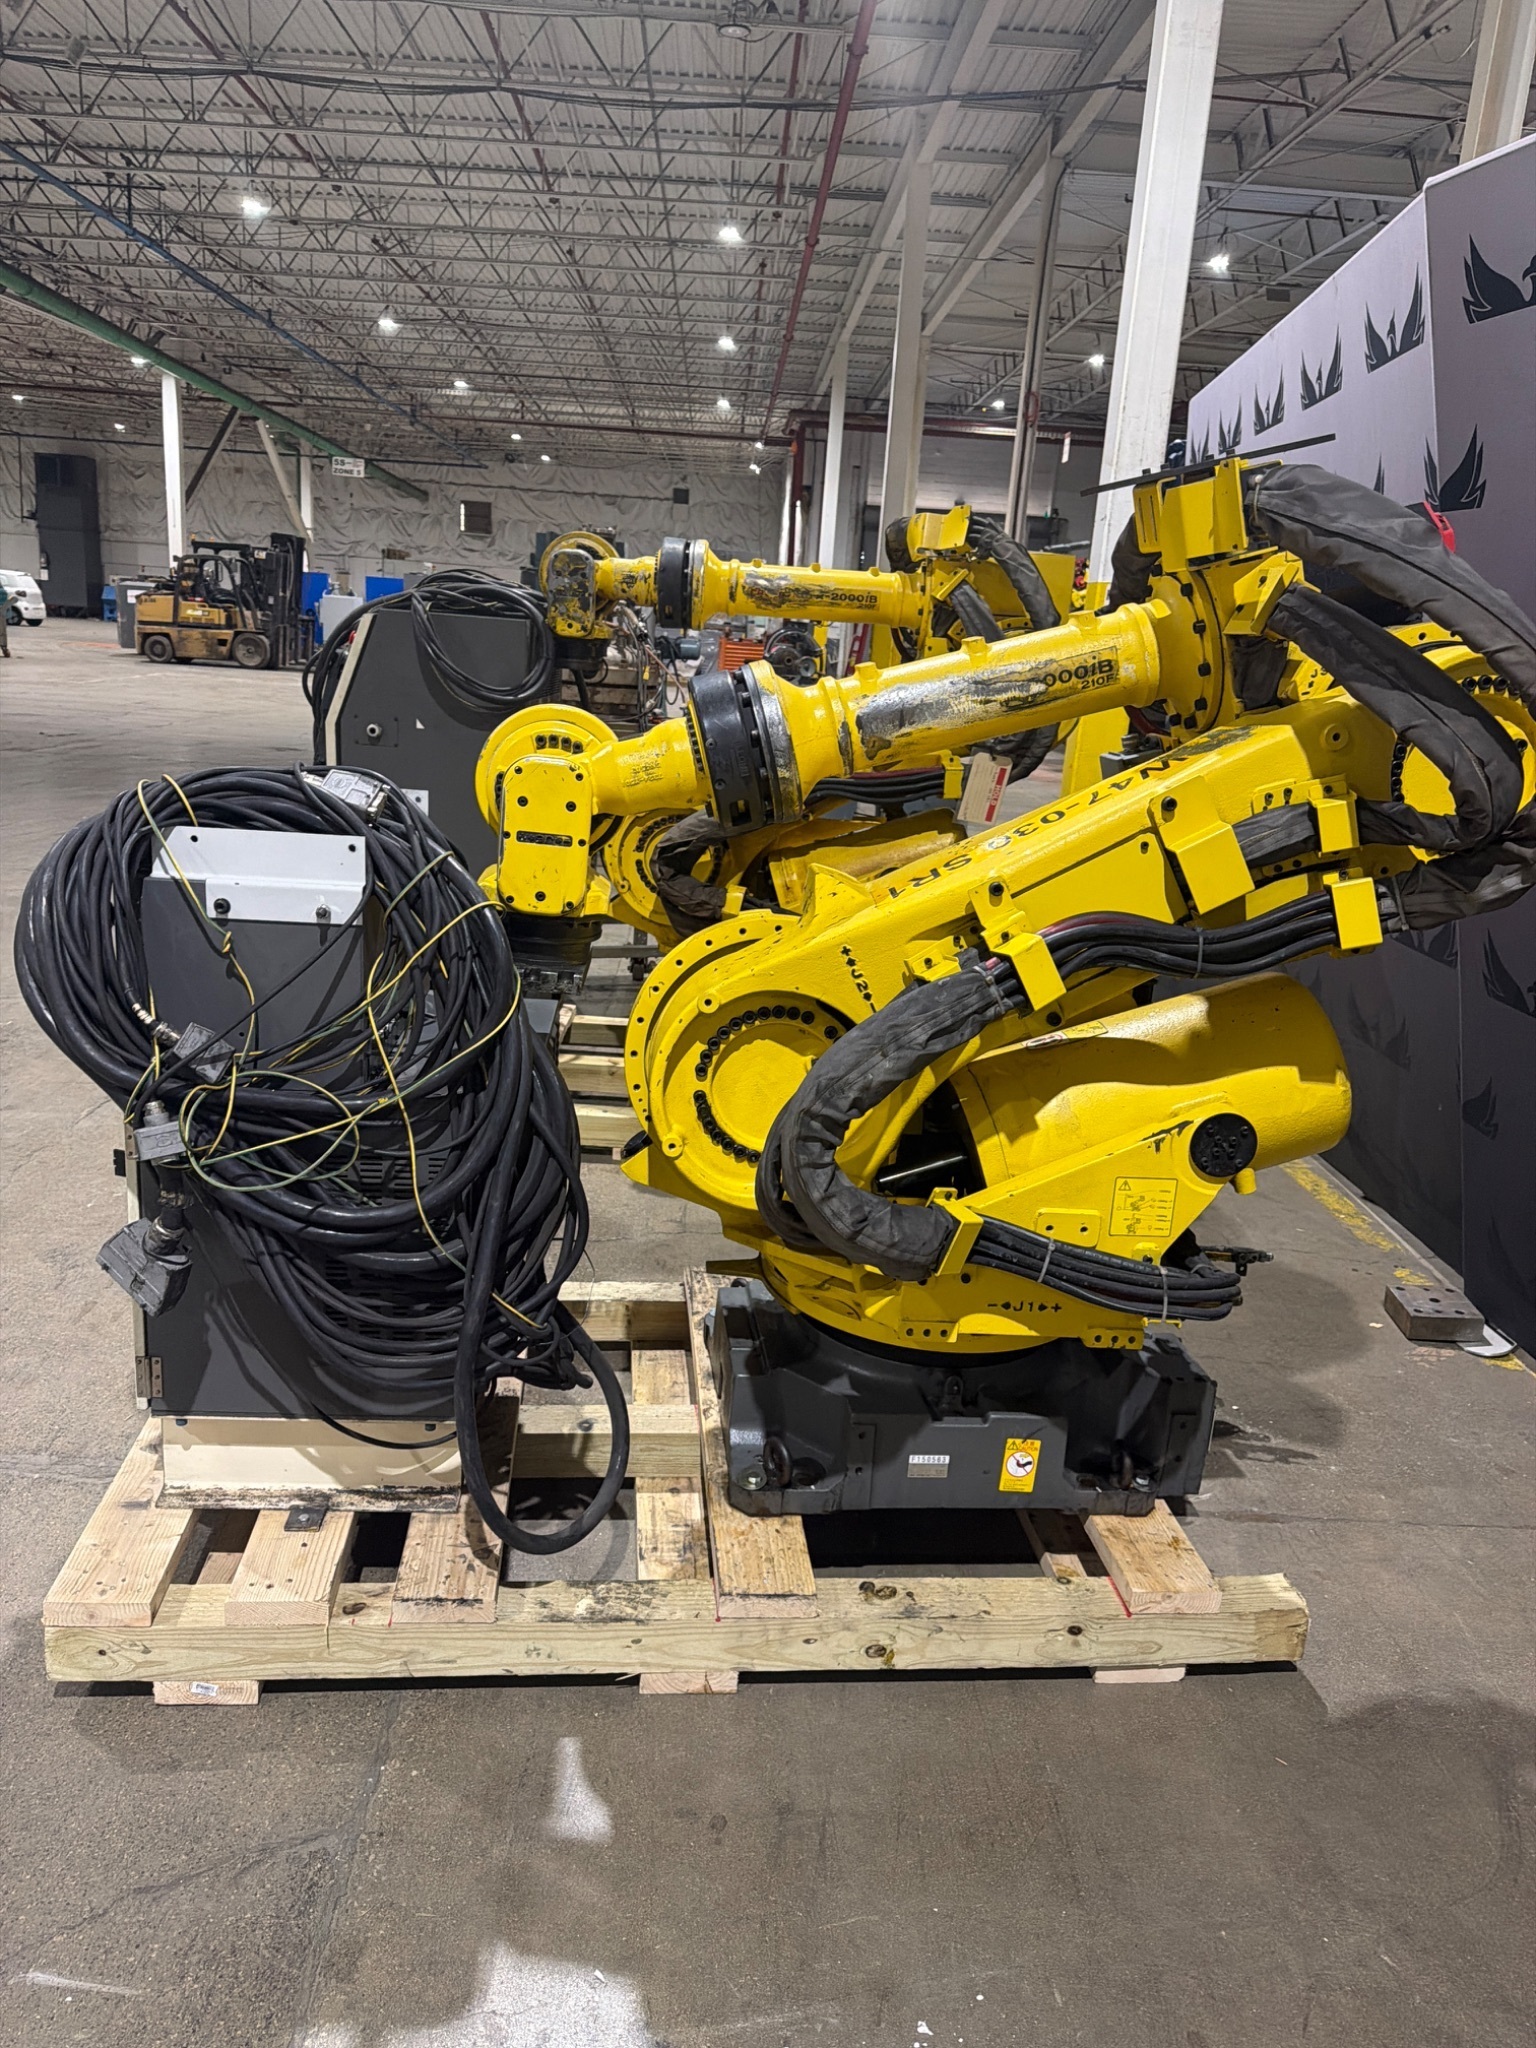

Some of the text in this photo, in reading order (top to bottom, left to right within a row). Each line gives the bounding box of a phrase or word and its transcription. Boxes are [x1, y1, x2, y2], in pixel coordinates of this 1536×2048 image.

[333, 467, 354, 475] ZONE
[815, 591, 878, 604] -2000iB
[1081, 673, 1115, 690] 210F
[991, 784, 1002, 807] HOLD
[888, 854, 973, 899] SR1
[851, 968, 869, 993] J2
[1012, 1301, 1034, 1312] J1
